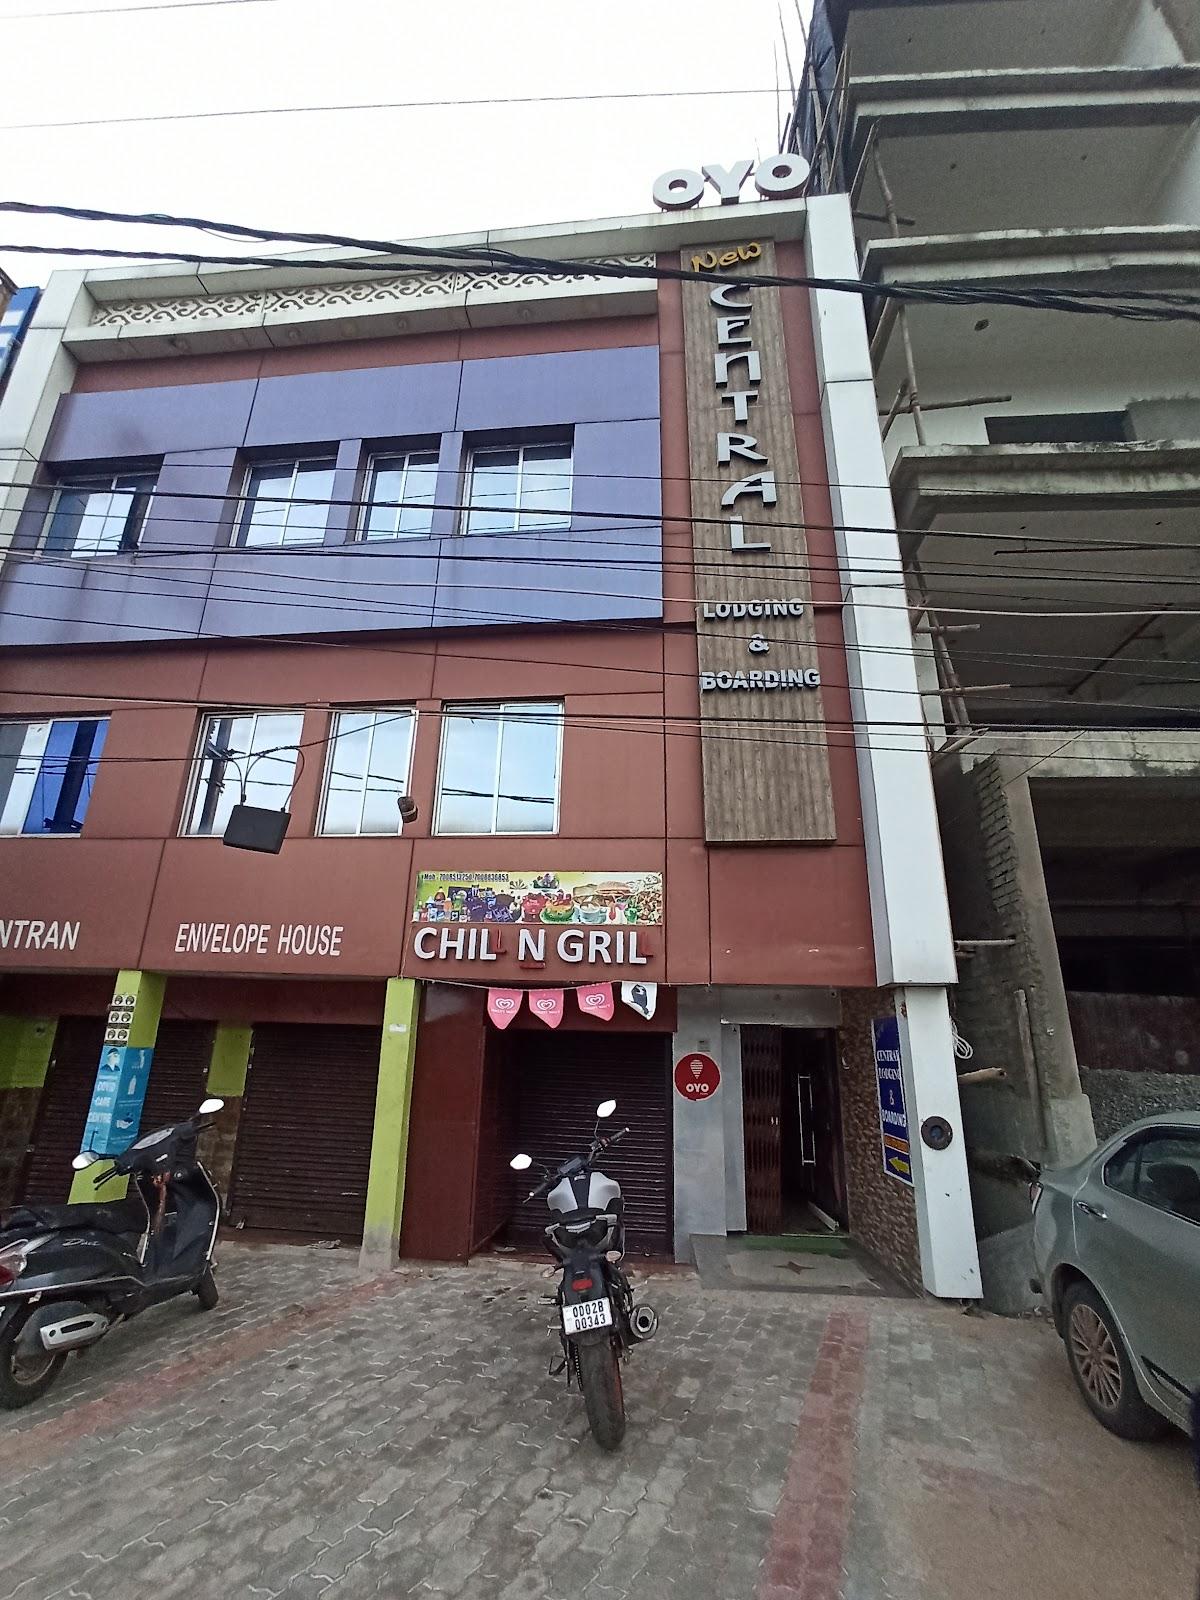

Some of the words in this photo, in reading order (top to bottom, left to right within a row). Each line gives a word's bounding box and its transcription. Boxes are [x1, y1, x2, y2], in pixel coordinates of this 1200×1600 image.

[652, 152, 810, 210] OYO
[690, 242, 762, 274] New
[710, 283, 778, 553] CENTRAL
[703, 598, 804, 620] LODGING
[748, 633, 770, 654] &
[701, 667, 821, 692] BOARDING
[175, 923, 271, 954] ENVELOPE
[277, 923, 344, 956] HOUSE
[518, 928, 546, 962] N
[685, 1083, 709, 1093] OYO
